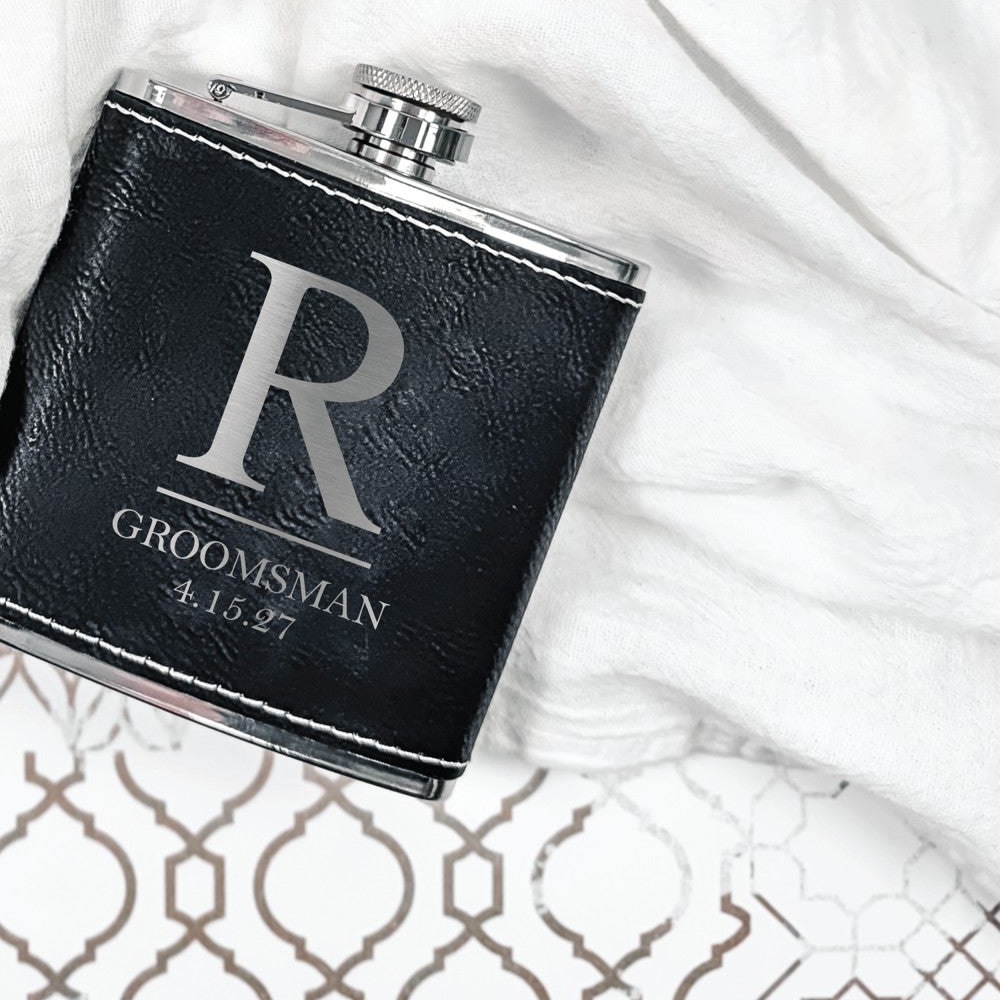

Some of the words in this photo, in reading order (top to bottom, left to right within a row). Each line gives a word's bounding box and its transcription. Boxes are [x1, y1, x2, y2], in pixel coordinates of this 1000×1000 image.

[175, 250, 405, 536] R
[111, 508, 391, 630] GROOMSMAN
[172, 579, 297, 640] 4.15.27
